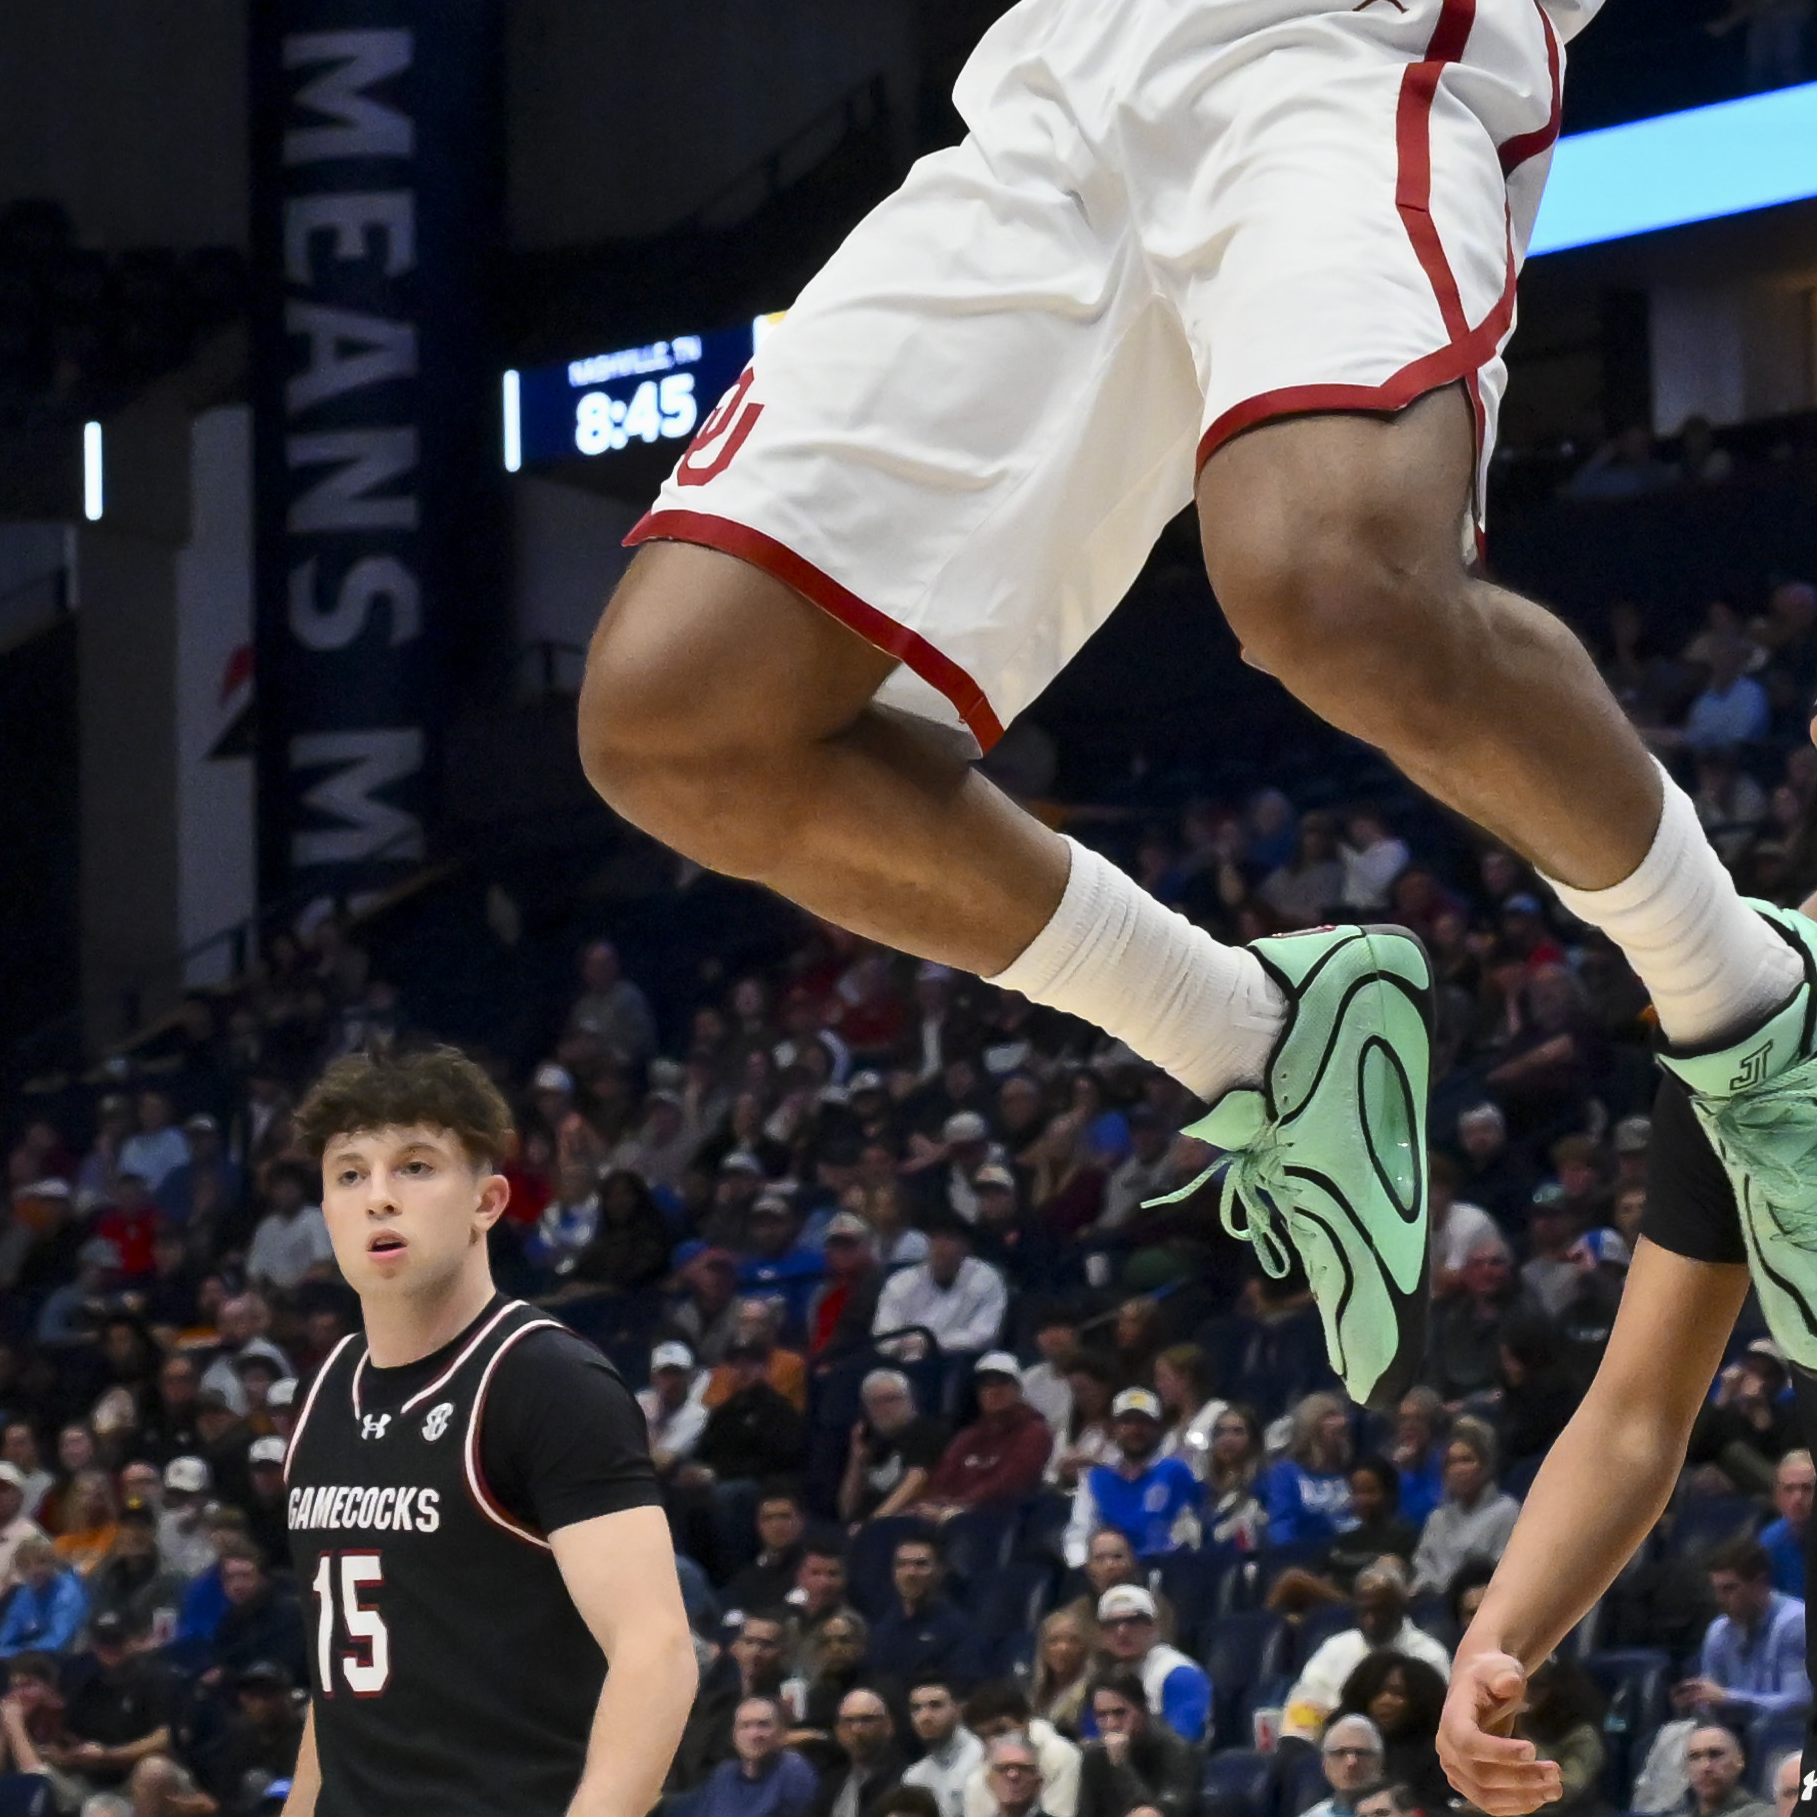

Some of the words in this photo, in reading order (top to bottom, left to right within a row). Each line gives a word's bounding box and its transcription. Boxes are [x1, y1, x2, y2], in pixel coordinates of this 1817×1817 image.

[282, 25, 423, 652] MEANS
[575, 372, 698, 456] 8:45
[288, 1485, 440, 1533] GAMECOCKS
[312, 1550, 390, 1697] 15
